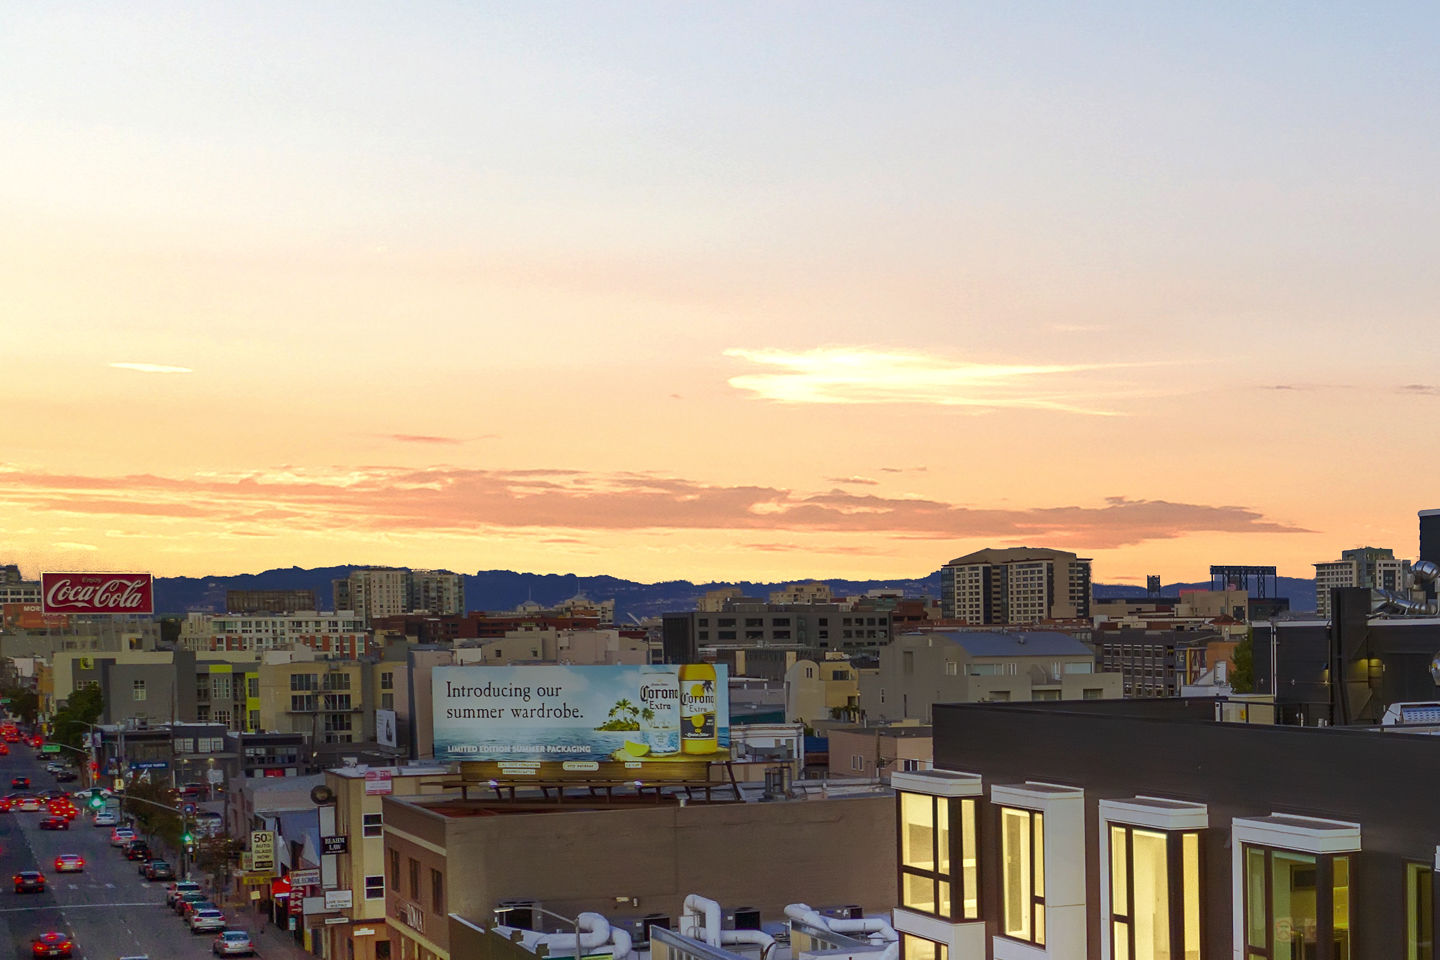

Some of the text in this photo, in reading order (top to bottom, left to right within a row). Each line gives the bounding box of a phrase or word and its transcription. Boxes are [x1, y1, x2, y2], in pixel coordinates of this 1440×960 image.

[47, 579, 147, 608] Coca-Cola
[446, 681, 562, 702] Introducing our
[446, 703, 584, 719] summer wardrobe.
[649, 701, 671, 710] Extra
[447, 745, 592, 753] LIMITED EDITION SUMMER PACKAGING
